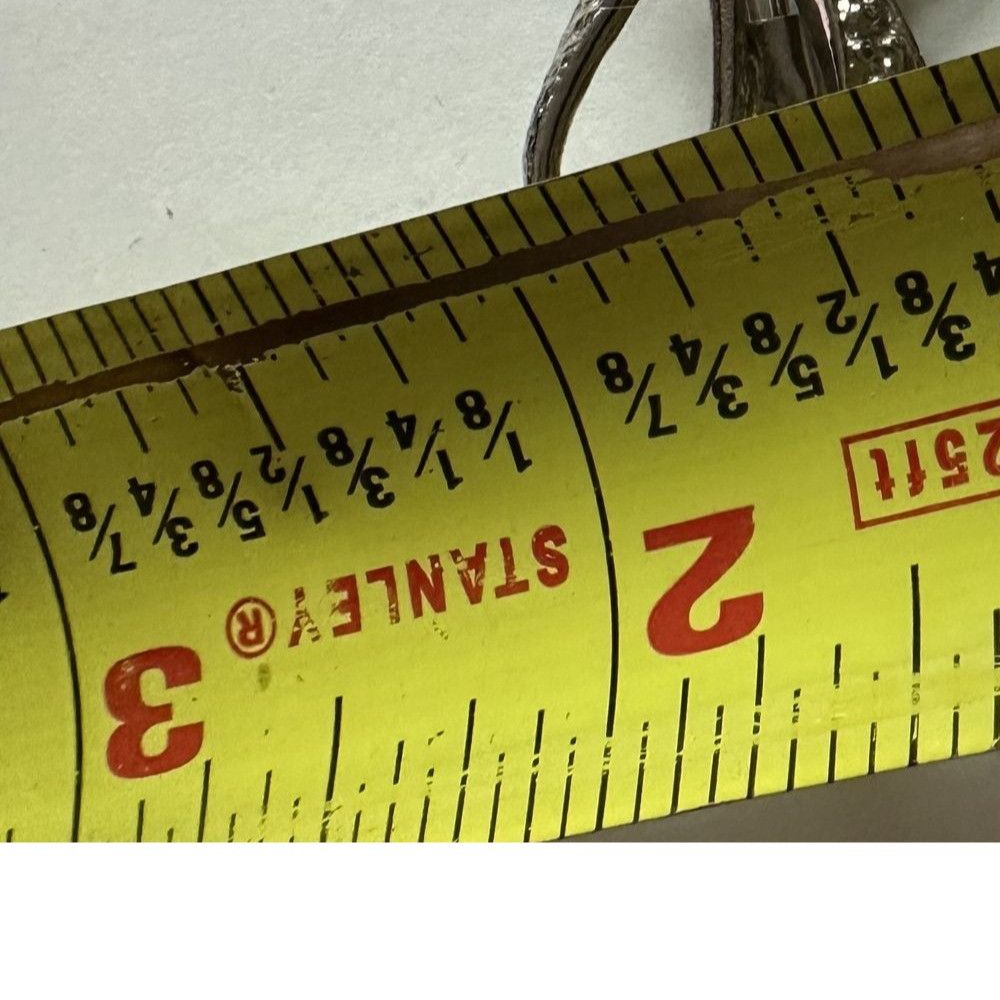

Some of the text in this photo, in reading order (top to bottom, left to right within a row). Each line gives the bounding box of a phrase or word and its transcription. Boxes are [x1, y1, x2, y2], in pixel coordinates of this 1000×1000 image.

[742, 311, 825, 402] 5/8
[817, 289, 899, 380] 1/2
[895, 270, 977, 361] 3/8
[596, 351, 678, 438] 7/8
[669, 334, 749, 419] 3/4
[62, 389, 533, 574] 1/8 1/4 3/8 1/2 5/8 3/4 7/8
[642, 504, 765, 656] 2
[103, 645, 205, 779] 3
